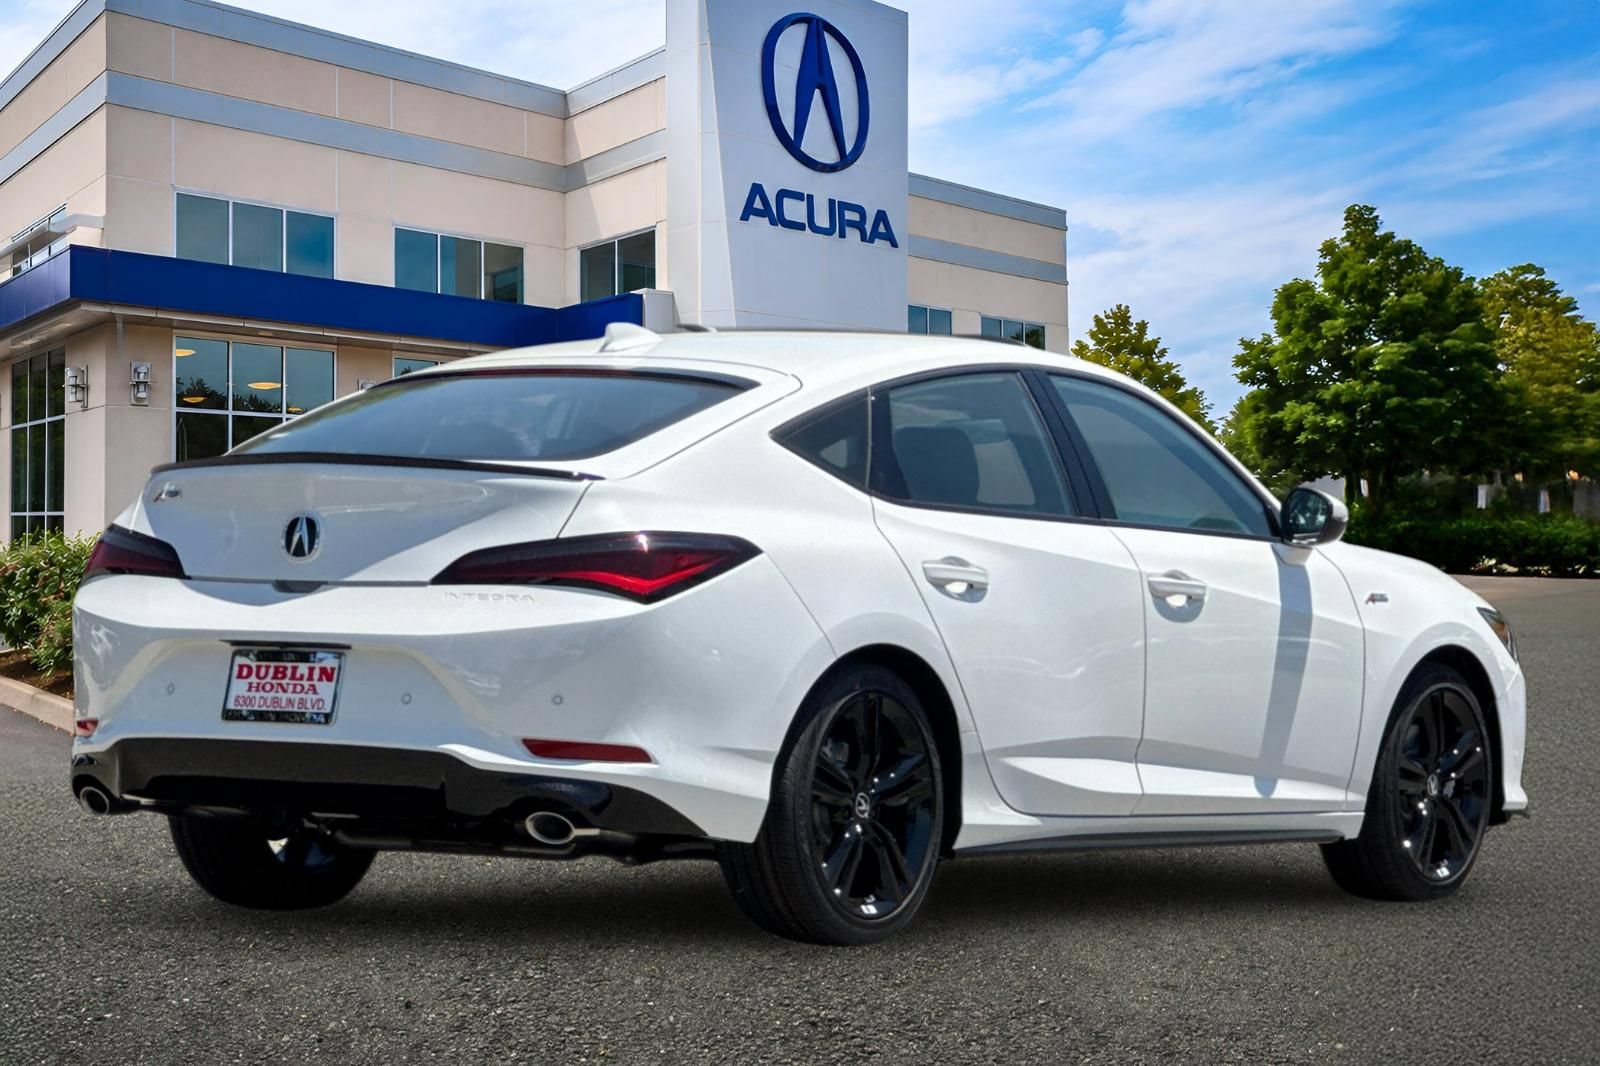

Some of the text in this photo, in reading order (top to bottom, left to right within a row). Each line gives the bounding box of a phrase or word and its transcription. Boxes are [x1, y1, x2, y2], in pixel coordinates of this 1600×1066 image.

[739, 182, 899, 248] ACURA
[443, 592, 535, 602] INTEGRA
[235, 663, 336, 682] DUBLIN
[246, 681, 319, 695] HONDA
[234, 695, 327, 711] 6300 DUBLIN BLVD.
